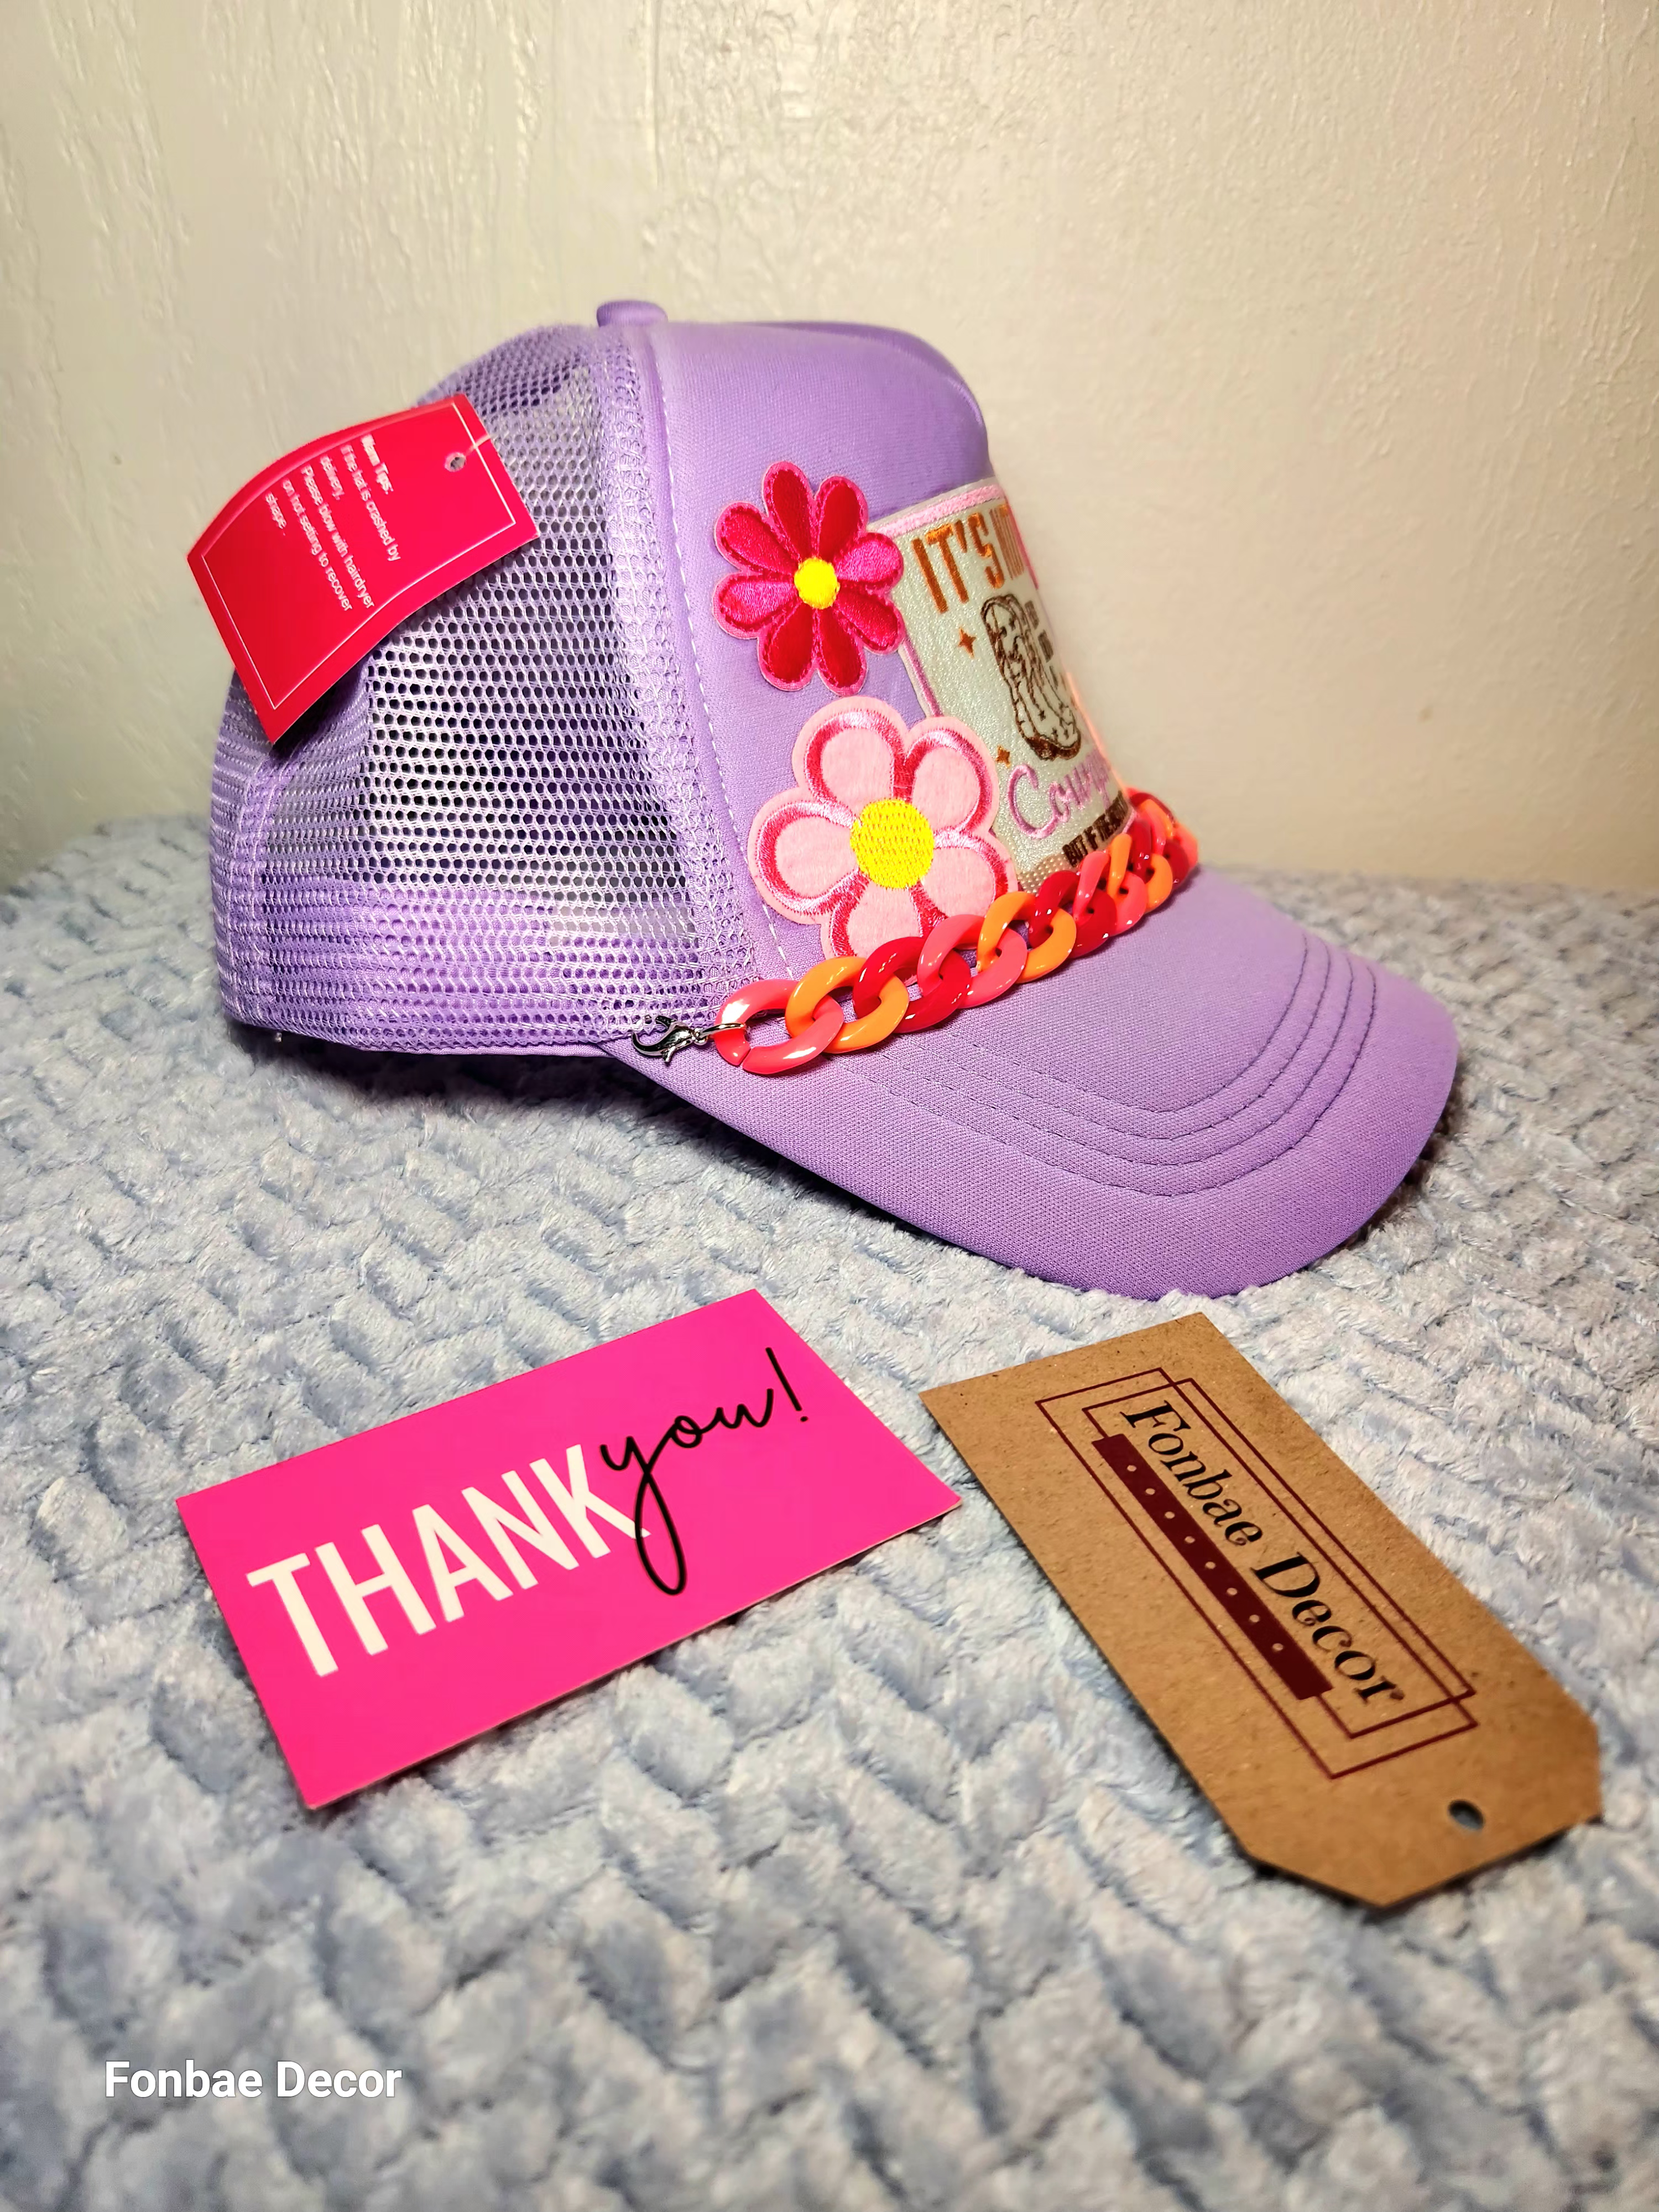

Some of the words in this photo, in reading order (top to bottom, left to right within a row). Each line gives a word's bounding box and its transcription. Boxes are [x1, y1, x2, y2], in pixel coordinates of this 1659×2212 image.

[283, 480, 294, 496] on
[291, 494, 305, 517] hot
[300, 515, 322, 555] setting
[319, 552, 328, 567] to
[326, 567, 352, 611] recover
[301, 466, 323, 505] Please
[319, 504, 336, 531] blow
[332, 532, 348, 557] with
[344, 555, 374, 608] hairdryer
[367, 501, 395, 545] crashed
[387, 544, 400, 561] by
[912, 513, 1005, 614] IT'S
[246, 1443, 651, 1677] THANK
[600, 1348, 808, 1596] you!
[1119, 1400, 1264, 1547] Fonbae
[1250, 1551, 1405, 1705] Decor
